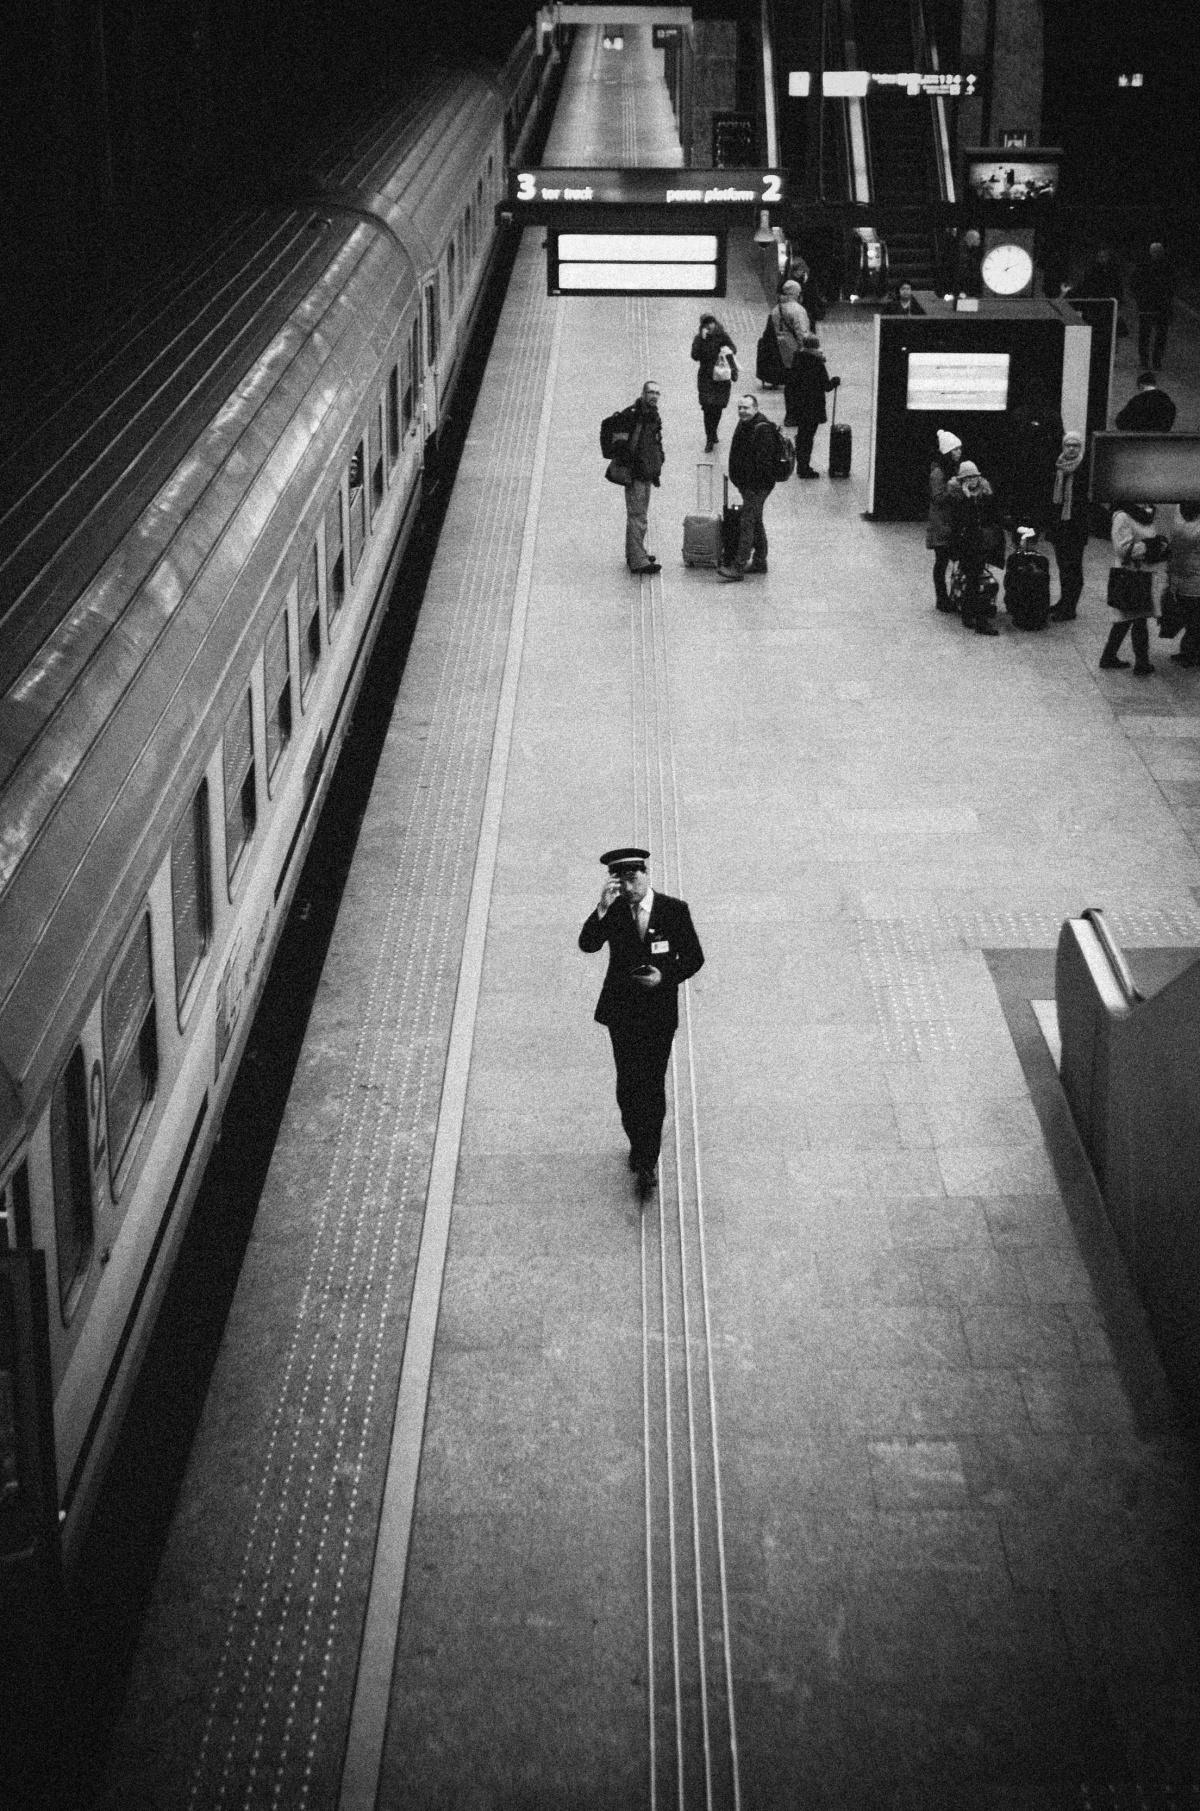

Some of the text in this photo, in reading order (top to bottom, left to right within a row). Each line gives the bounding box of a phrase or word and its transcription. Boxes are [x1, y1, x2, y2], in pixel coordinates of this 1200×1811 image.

[517, 173, 594, 200] 3 tor track
[704, 187, 755, 203] platform
[762, 174, 783, 202] 2
